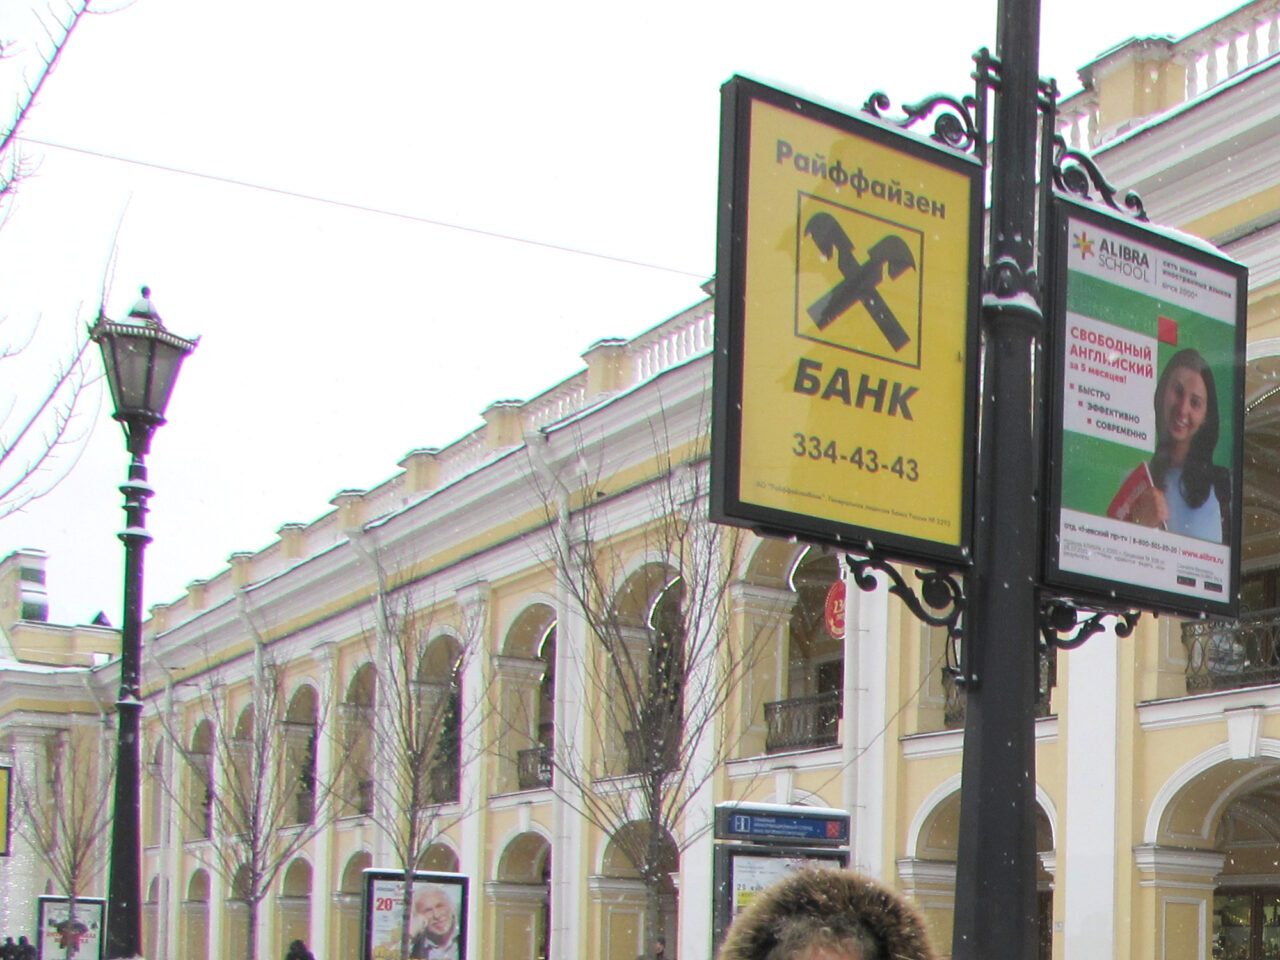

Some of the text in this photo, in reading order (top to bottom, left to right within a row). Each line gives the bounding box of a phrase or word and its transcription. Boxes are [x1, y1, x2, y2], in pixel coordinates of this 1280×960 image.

[776, 139, 946, 219] Райффайзен
[1099, 238, 1150, 269] ALIBRA
[1098, 255, 1150, 284] SCHOOL
[1070, 326, 1152, 361] СВОБОДНЫЙ
[1070, 362, 1127, 384] за 5 месяцев!
[793, 357, 920, 422] БАНК
[1078, 384, 1111, 401] БЫСТРО
[1087, 402, 1140, 424] ЭФФЕКТИВНО
[1095, 420, 1147, 441] СОВРЕМЕННО
[792, 432, 920, 482] 334-43-43
[833, 599, 844, 613] 23
